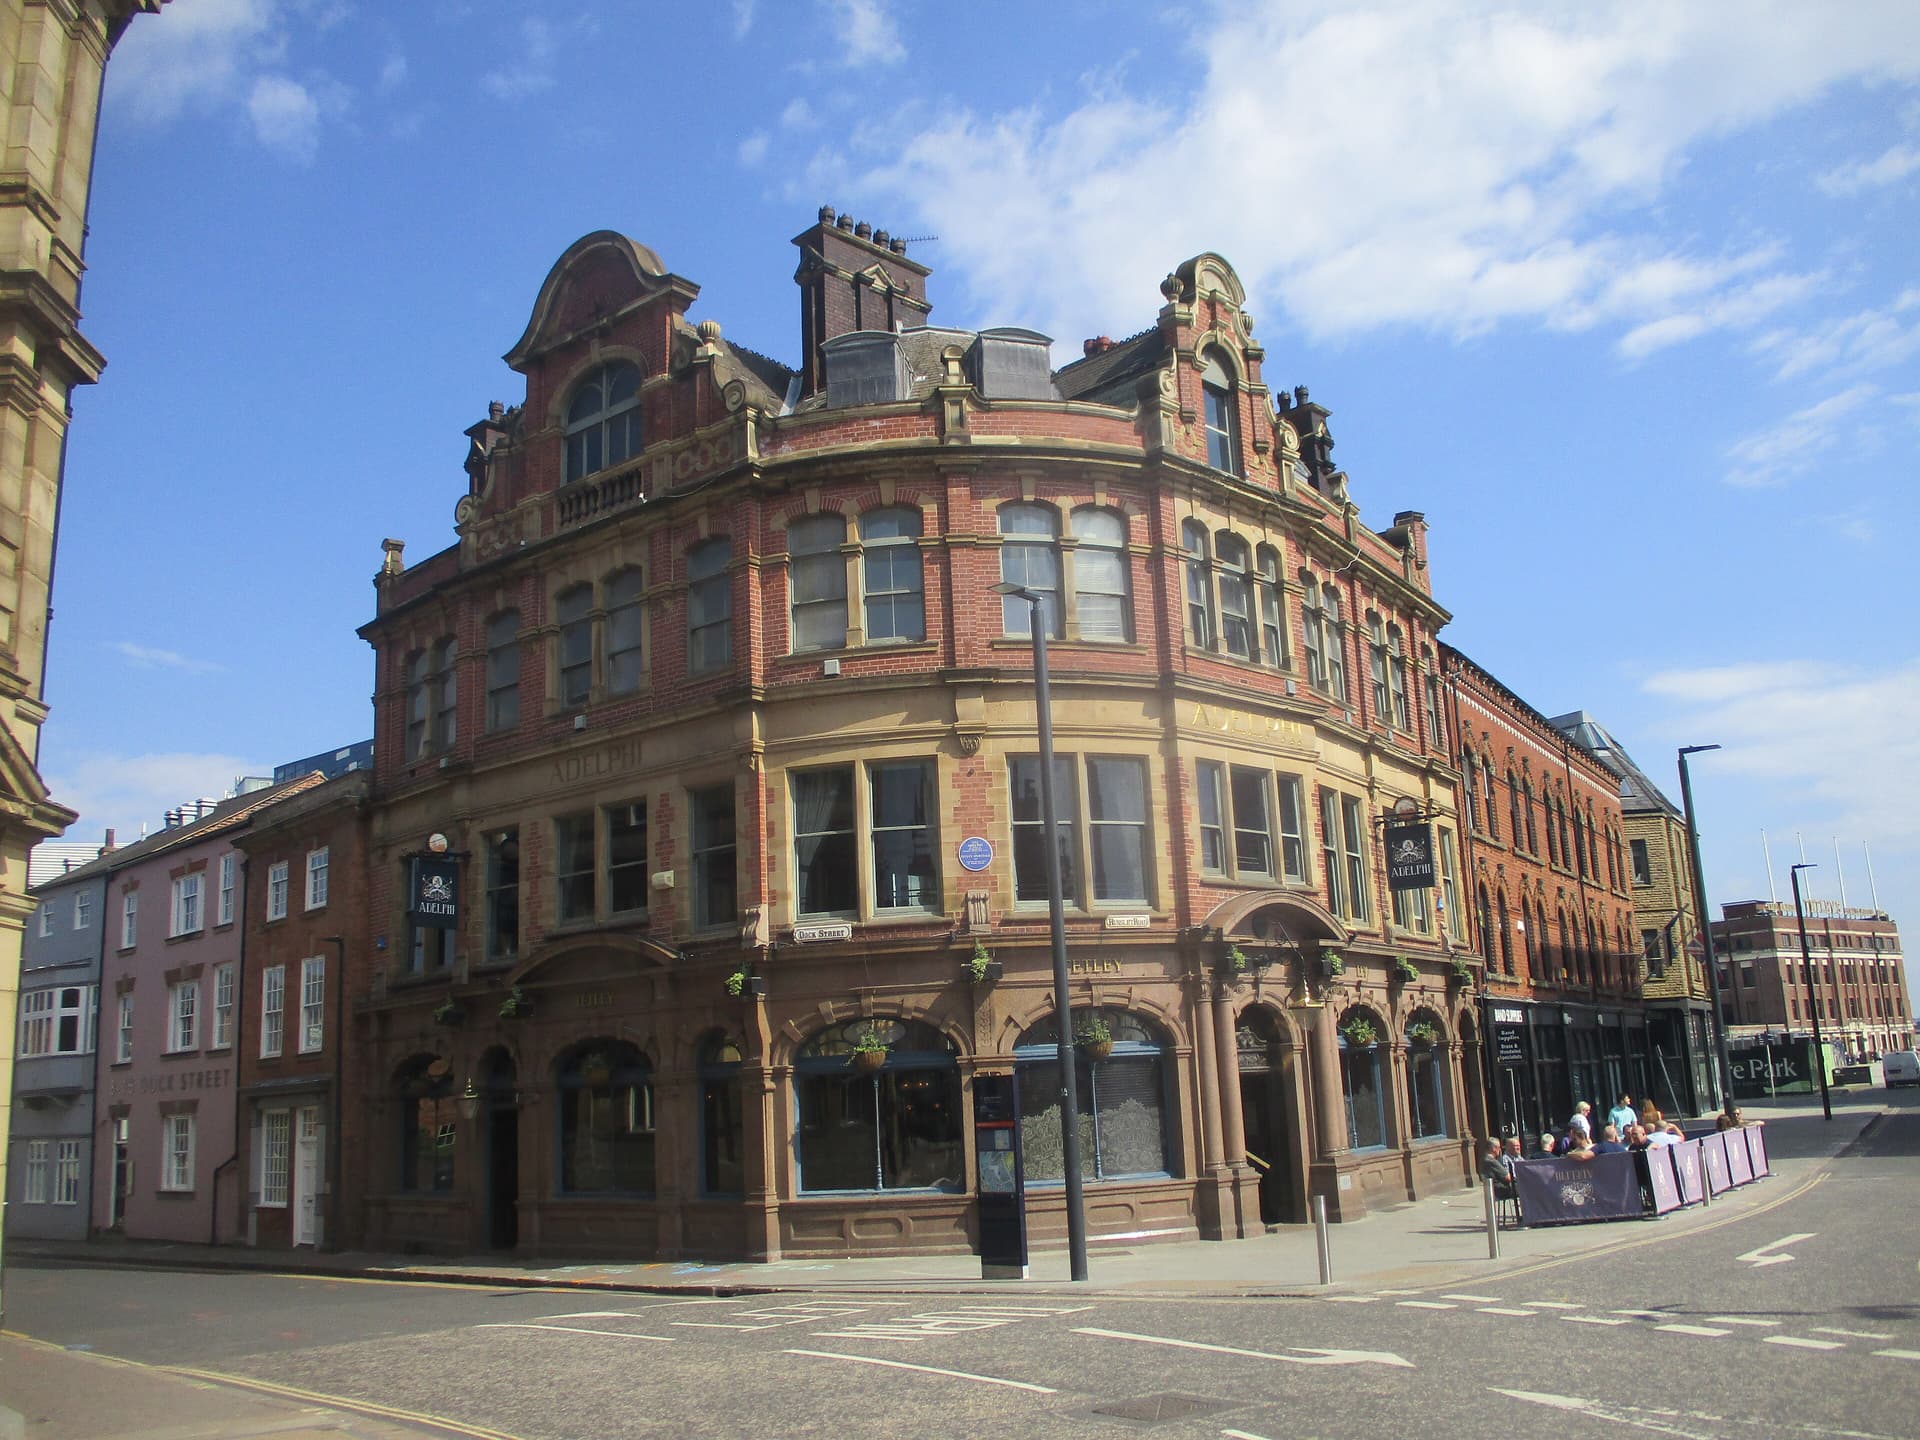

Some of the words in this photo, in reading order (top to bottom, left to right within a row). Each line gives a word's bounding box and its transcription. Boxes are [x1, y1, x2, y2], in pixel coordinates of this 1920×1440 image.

[1191, 702, 1303, 745] ADELPHI
[551, 736, 643, 783] ADELPHI
[1391, 863, 1431, 878] ADELPHI
[418, 901, 455, 915] ADELPHI
[818, 929, 845, 938] STREET
[1066, 958, 1122, 976] ETLEY
[1749, 1057, 1798, 1079] Park
[180, 1069, 230, 1091] STREET
